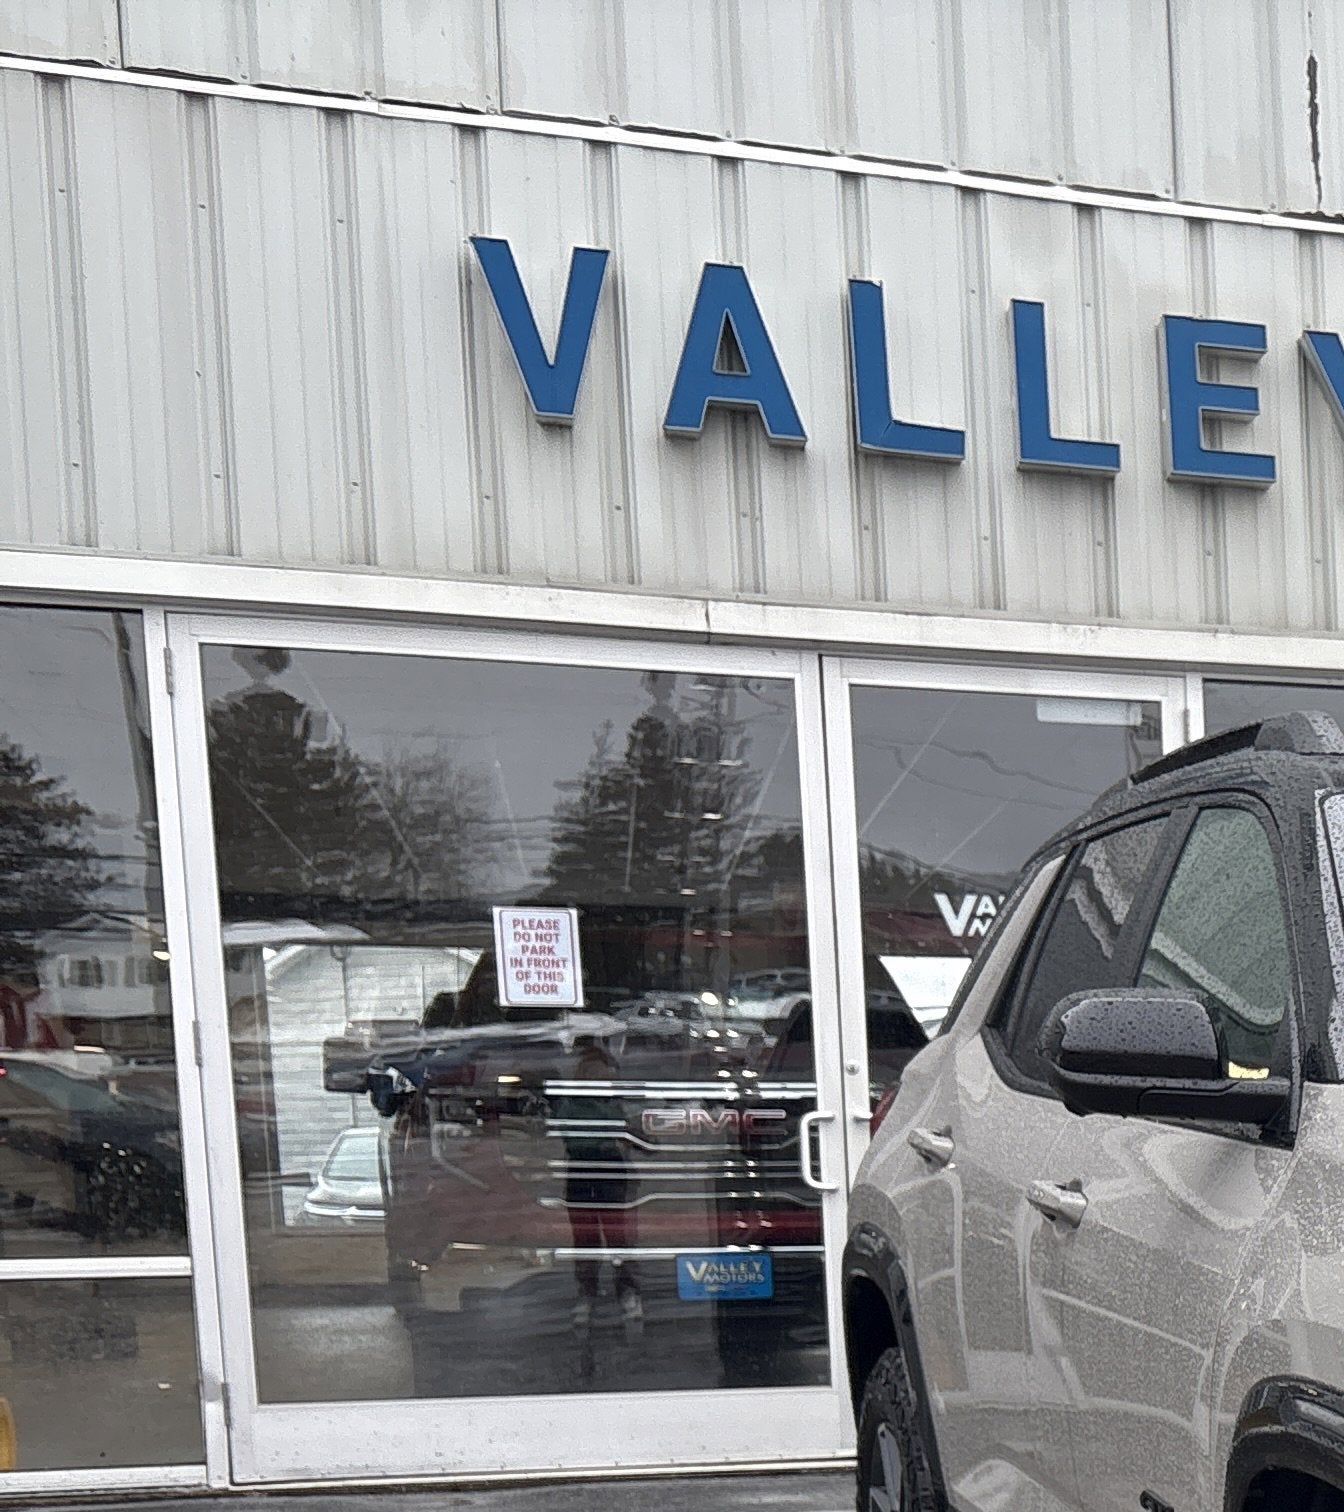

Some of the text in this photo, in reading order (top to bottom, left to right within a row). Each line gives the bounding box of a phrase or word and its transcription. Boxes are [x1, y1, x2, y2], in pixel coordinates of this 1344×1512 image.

[512, 918, 561, 930] PLEASE
[513, 932, 561, 943] DO NOT
[521, 945, 555, 956] PARK
[509, 957, 568, 969] IN FRONT
[515, 970, 565, 982] OF THIS
[523, 983, 559, 995] DOOR
[642, 1108, 788, 1136] GMC
[685, 1260, 763, 1282] VALLEY
[703, 1272, 765, 1284] MOTORS
